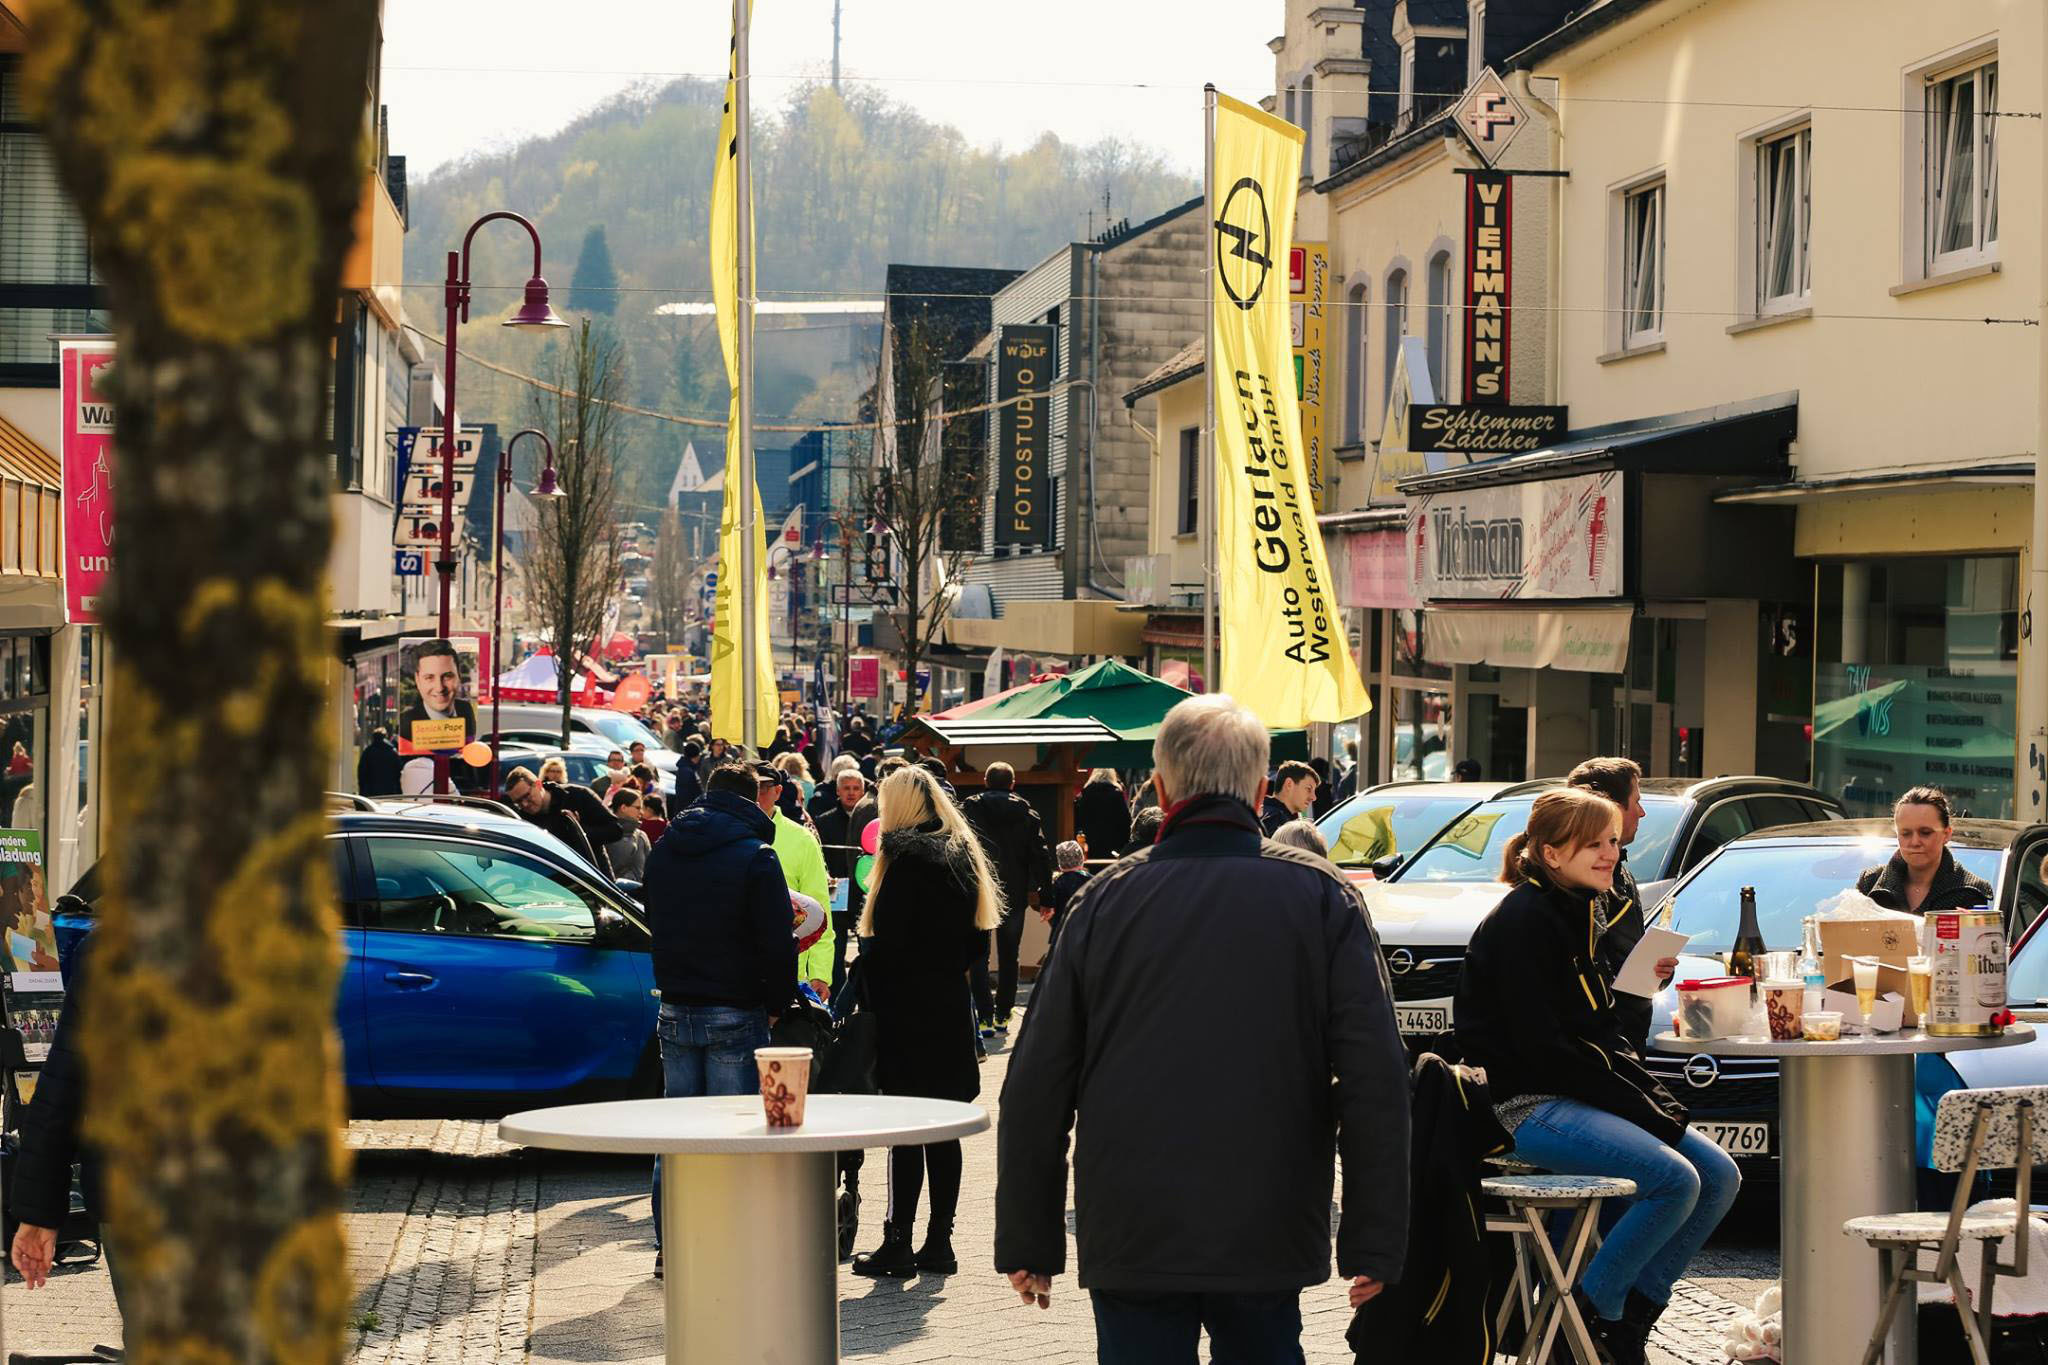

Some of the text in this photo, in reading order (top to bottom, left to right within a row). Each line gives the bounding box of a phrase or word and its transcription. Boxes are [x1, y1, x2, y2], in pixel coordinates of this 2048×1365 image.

[1473, 183, 1505, 395] VIEHMANN'S
[1421, 408, 1555, 432] Schlemmer
[1014, 369, 1034, 531] FOTOSTUDIO
[1434, 428, 1541, 450] Lädchen
[1258, 374, 1330, 664] Westerwald GmbH
[1282, 587, 1306, 664] Auto
[1846, 665, 1872, 694] TAXI
[0, 836, 27, 847] ndere
[0, 847, 42, 866] ladung
[1407, 1012, 1443, 1030] 4438
[1714, 1126, 1766, 1150] 7769
